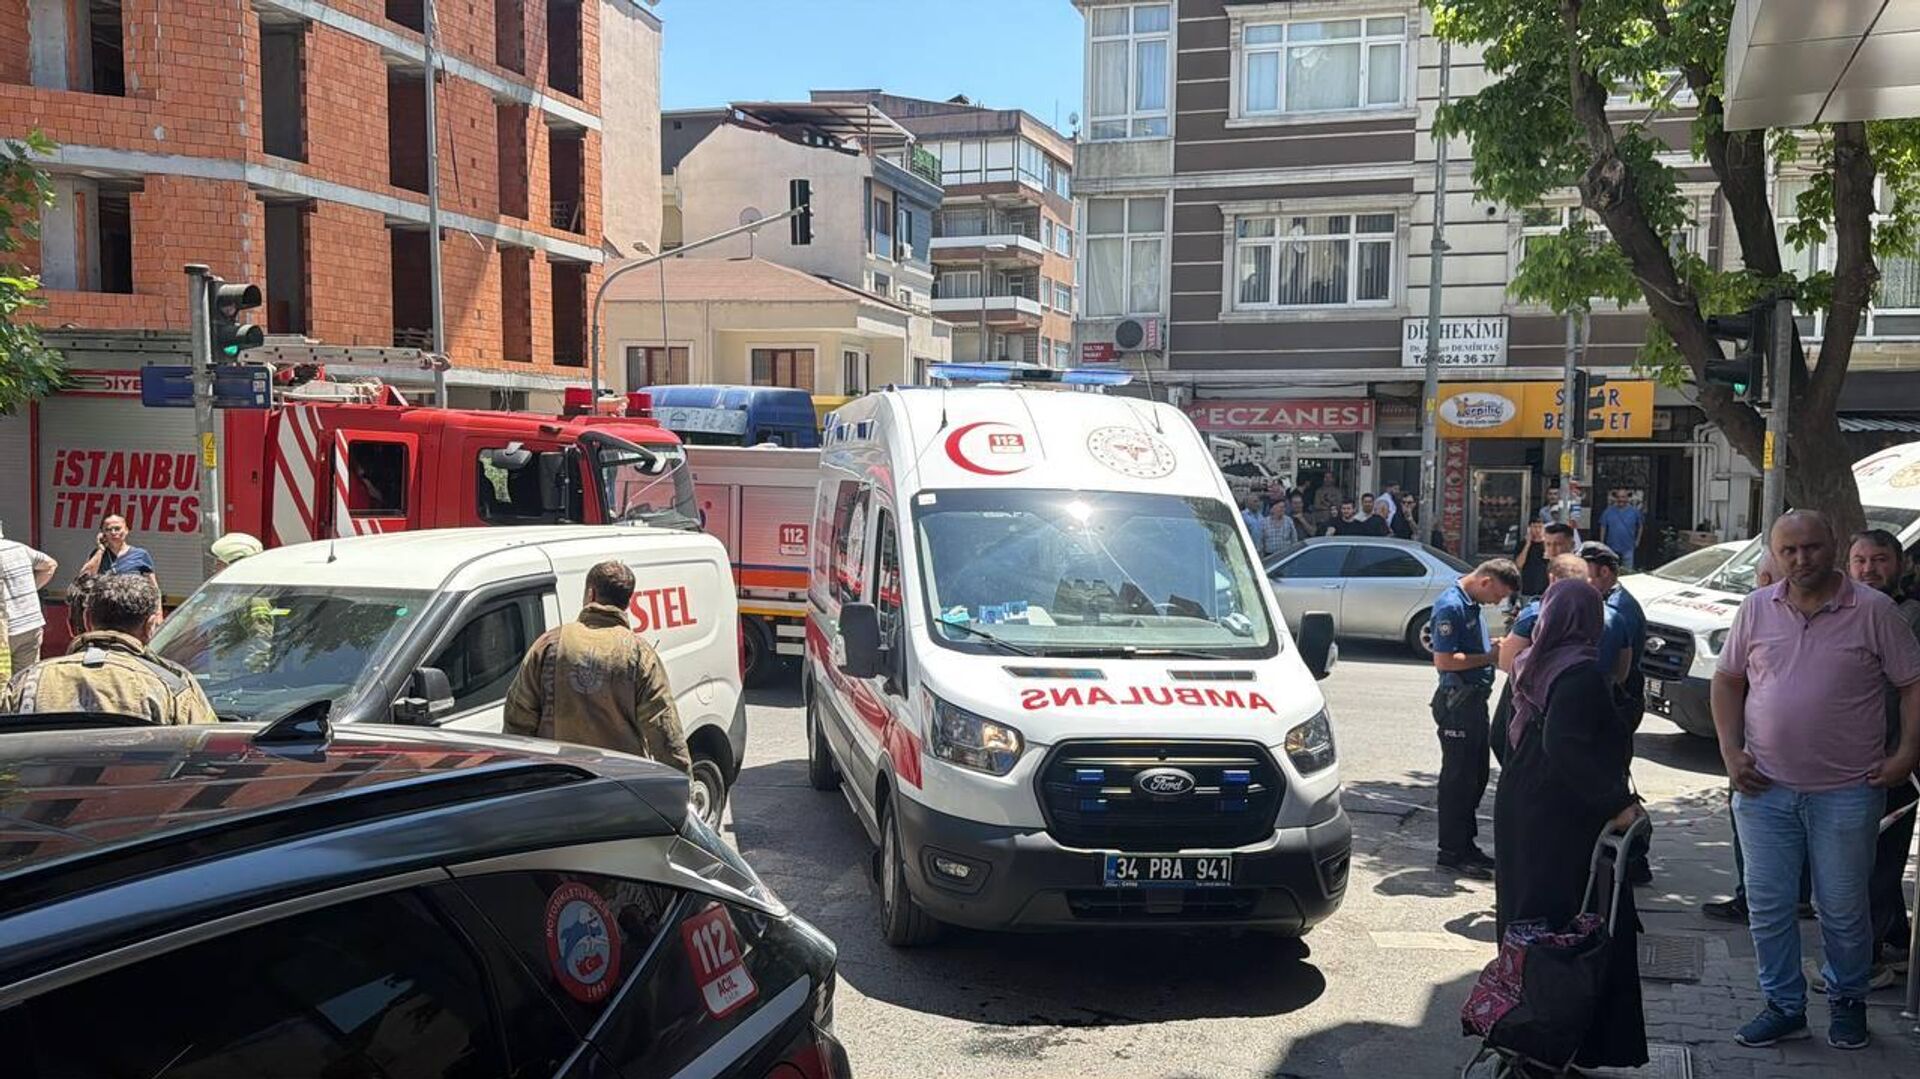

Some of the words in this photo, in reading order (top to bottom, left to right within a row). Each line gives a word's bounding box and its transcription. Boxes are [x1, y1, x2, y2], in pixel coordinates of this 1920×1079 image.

[1407, 319, 1429, 340] Dİ
[1439, 318, 1504, 339] HEKİMİ
[1439, 354, 1460, 365] 624
[1463, 354, 1478, 364] 36
[1480, 353, 1497, 364] 37
[1208, 402, 1371, 426] ECZANESİ
[1543, 412, 1632, 430] BEET
[991, 435, 1019, 446] 112
[53, 492, 203, 533] İTFAİYES
[783, 528, 805, 543] 112
[629, 586, 698, 634] STEL
[1150, 775, 1184, 791] Ford
[1116, 858, 1139, 879] 34
[1149, 858, 1184, 879] PBA
[1196, 858, 1228, 880] 941
[691, 919, 736, 975] 112
